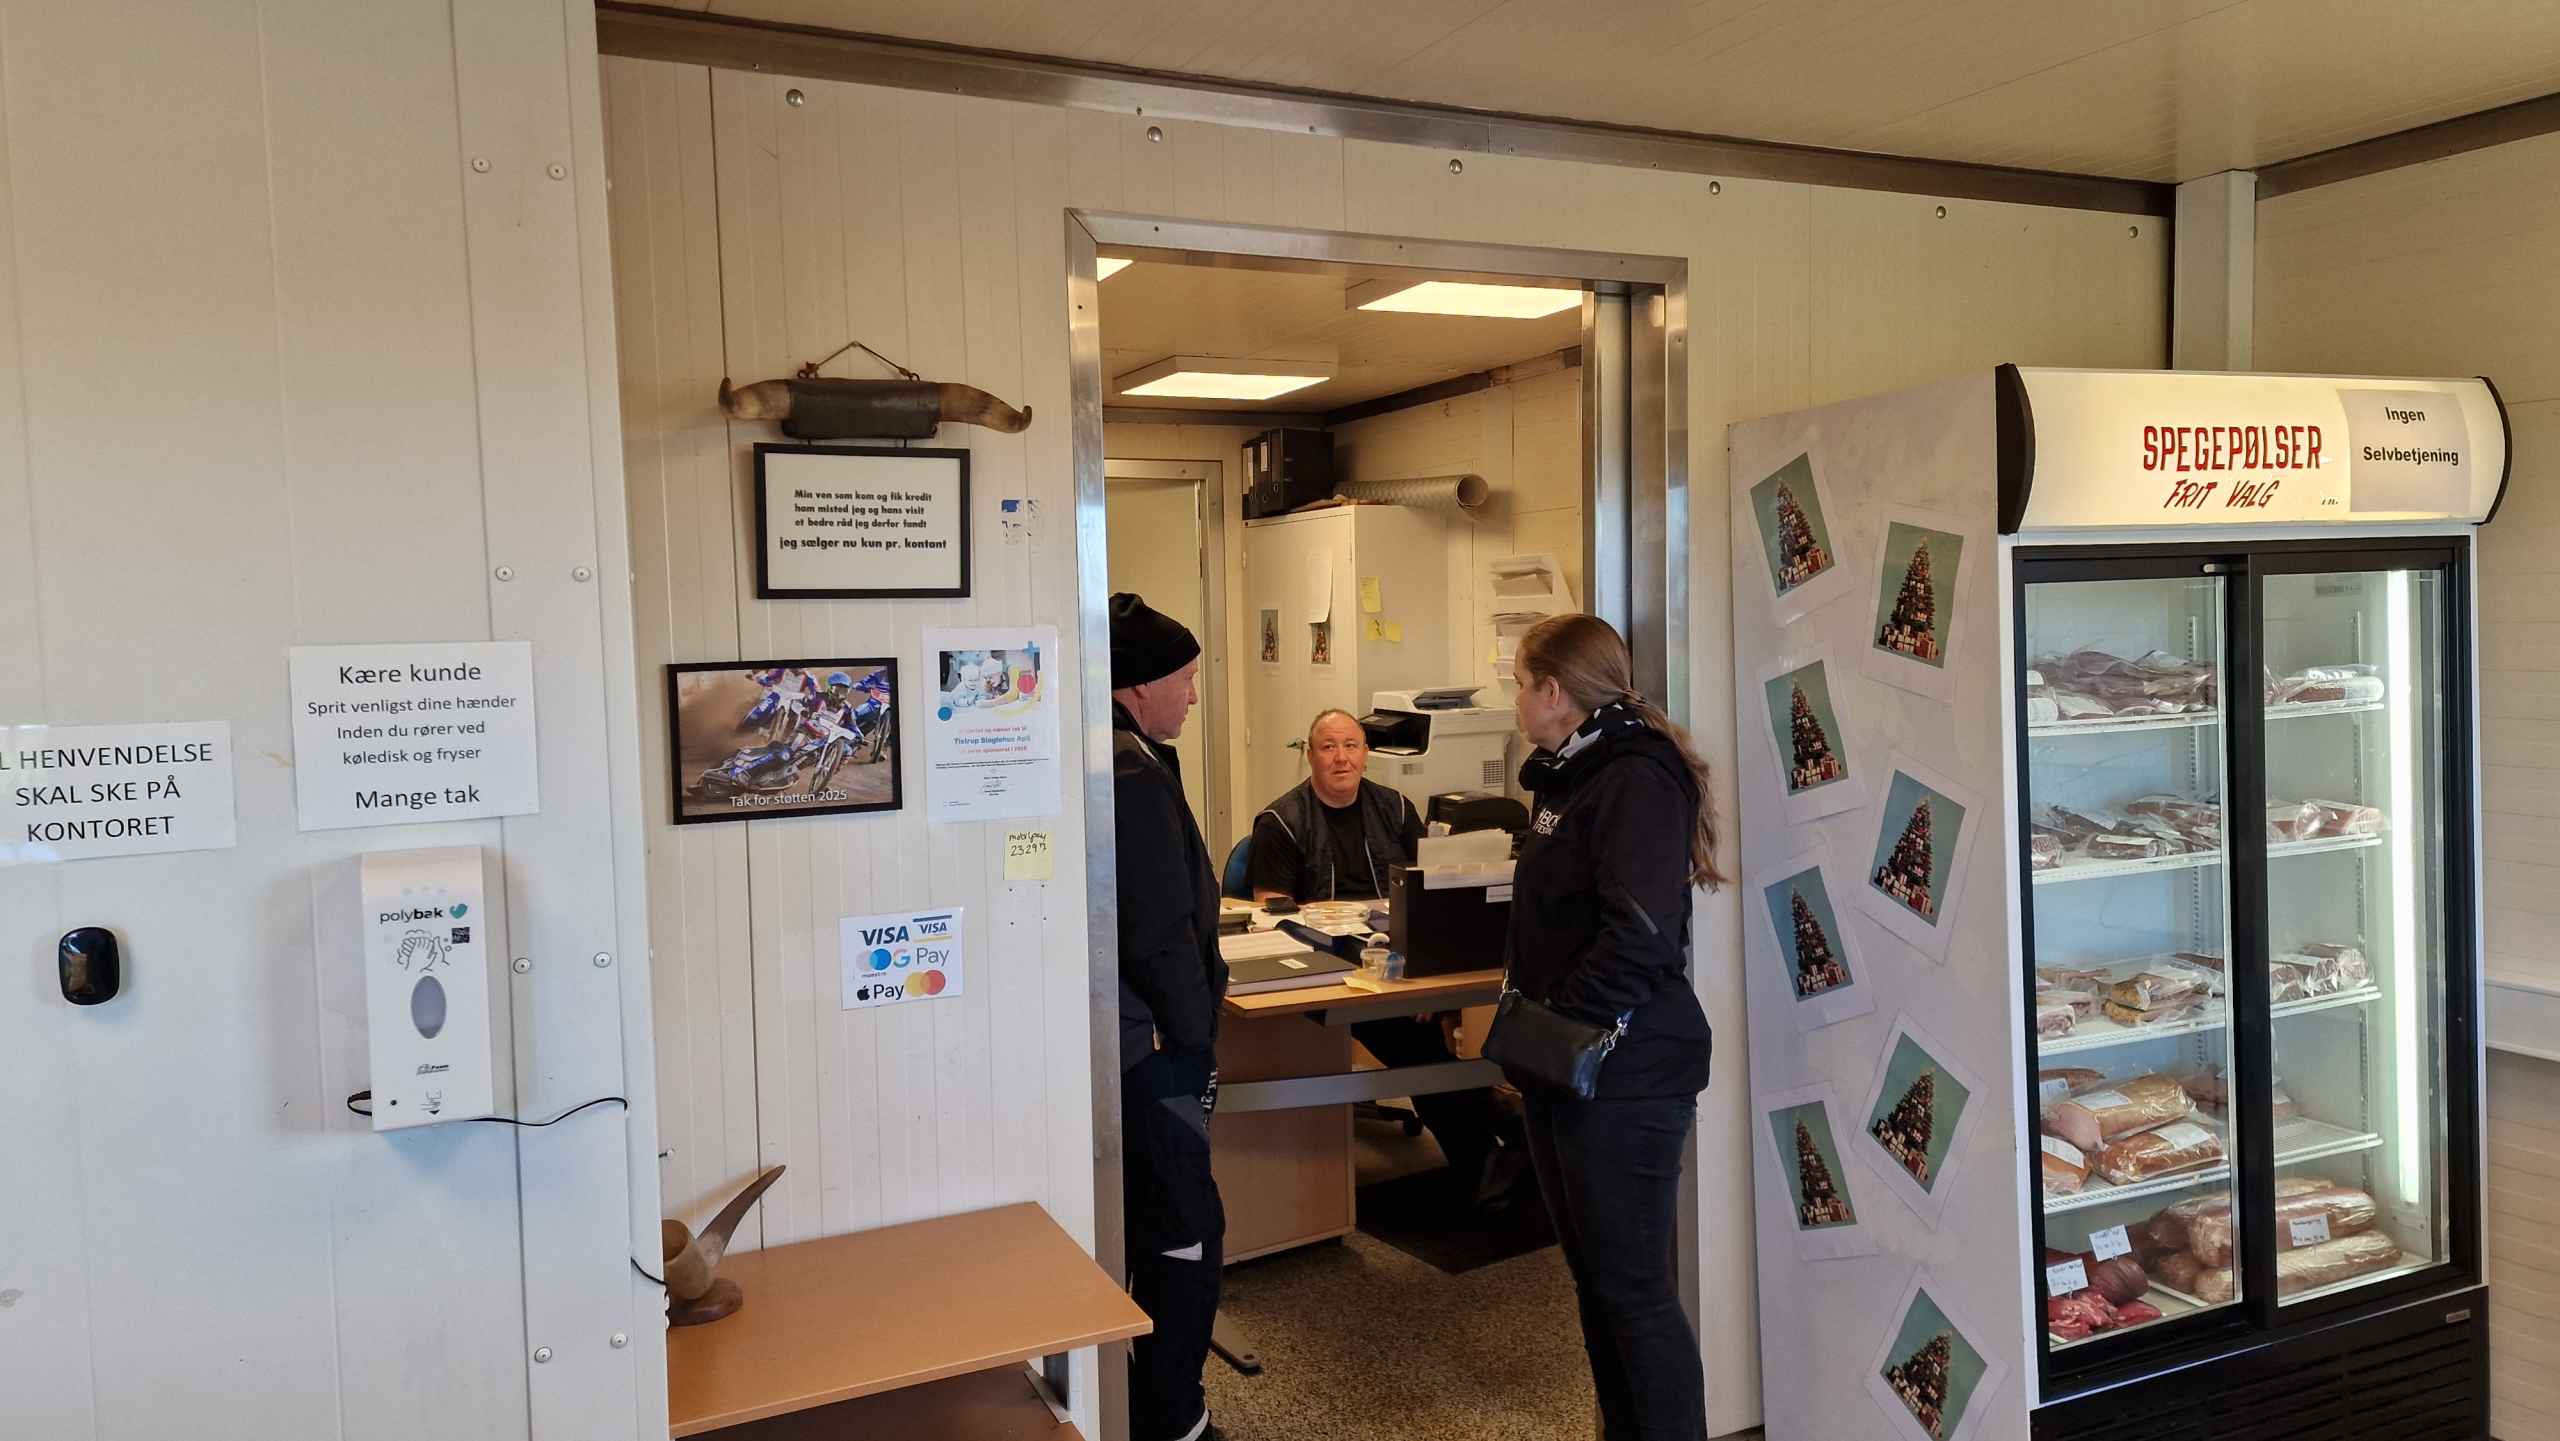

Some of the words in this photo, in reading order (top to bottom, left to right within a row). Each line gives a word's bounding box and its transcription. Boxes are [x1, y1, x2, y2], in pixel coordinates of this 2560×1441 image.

[2385, 407, 2425, 423] Ingen
[2143, 425, 2322, 472] SPEGEPØLSER
[2363, 446, 2459, 466] Selvbetjening
[794, 490, 813, 499] Min
[855, 490, 874, 500] kom
[877, 493, 888, 502] og
[905, 491, 932, 502] kredit
[2163, 479, 2218, 509] FRIT
[2225, 480, 2280, 508] VALG
[852, 505, 866, 516] jeg
[868, 507, 879, 516] og
[881, 505, 902, 515] hans
[905, 505, 925, 515] visit
[808, 517, 834, 527] bedre
[855, 519, 869, 529] jeg
[872, 518, 899, 528] derfor
[903, 519, 927, 528] fandt
[779, 536, 797, 550] jeg
[801, 536, 839, 550] sælger
[843, 539, 857, 548] nu
[861, 537, 882, 548] kun
[885, 540, 901, 551] pr.
[904, 537, 947, 549] kontant
[339, 666, 401, 684] Kære
[410, 662, 481, 682] kunde
[308, 701, 347, 717] Sprit
[351, 698, 413, 715] venligst
[418, 697, 451, 711] dine
[456, 695, 517, 709] hænder
[337, 725, 383, 740] Inden
[388, 724, 408, 737] du
[413, 725, 453, 737] rører
[458, 721, 485, 734] ved
[0, 752, 10, 770] L
[20, 743, 213, 769] HENVENDELSE
[343, 749, 409, 765] køledisk
[413, 751, 432, 764] og
[437, 747, 482, 762] fryser
[16, 785, 82, 807] SKAL
[90, 782, 137, 803] SKE
[147, 774, 181, 800] PÅ
[355, 789, 437, 810] Mange
[444, 784, 480, 804] tak
[729, 795, 751, 808] Tak
[753, 794, 770, 806] for
[818, 790, 847, 801] 2025
[27, 816, 175, 842] KONTORET
[380, 907, 443, 925] polybak
[857, 925, 910, 946] VISA
[918, 921, 948, 935] VISA
[916, 947, 950, 967] Pay
[873, 983, 905, 1001] Pay
